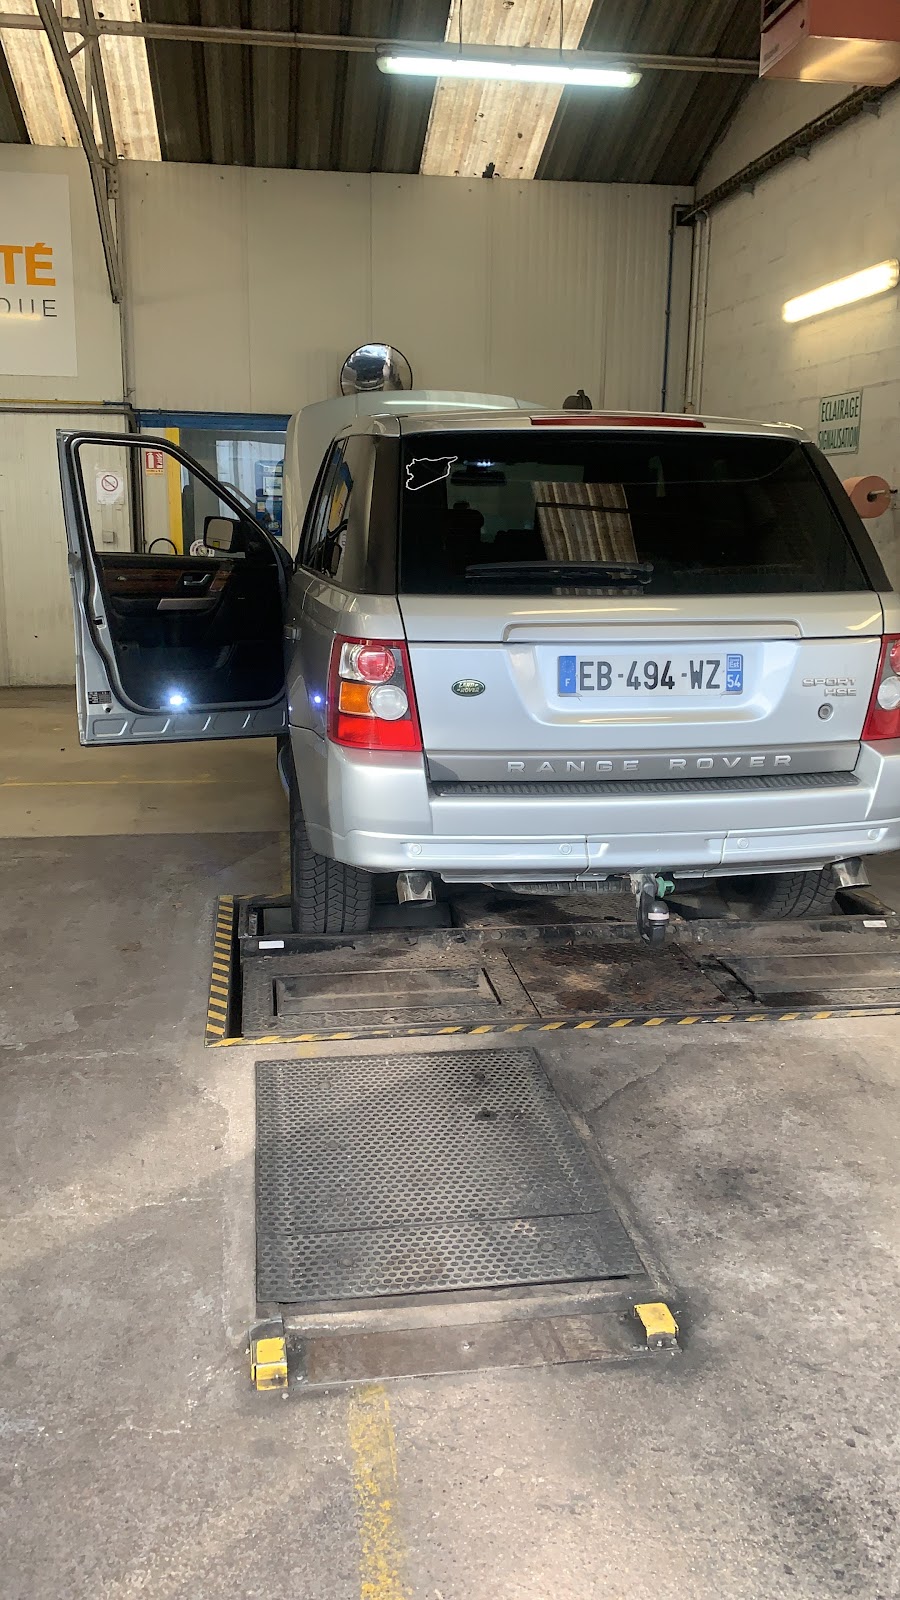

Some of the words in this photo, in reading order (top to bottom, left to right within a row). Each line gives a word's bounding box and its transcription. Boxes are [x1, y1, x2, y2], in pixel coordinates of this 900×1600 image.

[821, 396, 859, 422] ECLAIRAGE
[818, 426, 859, 450] SIGNALISATION
[565, 678, 570, 687] F
[727, 674, 741, 688] 54
[802, 678, 856, 687] SPORT
[824, 688, 857, 696] HSE
[506, 760, 640, 773] RANGE
[669, 755, 792, 771] ROVER
